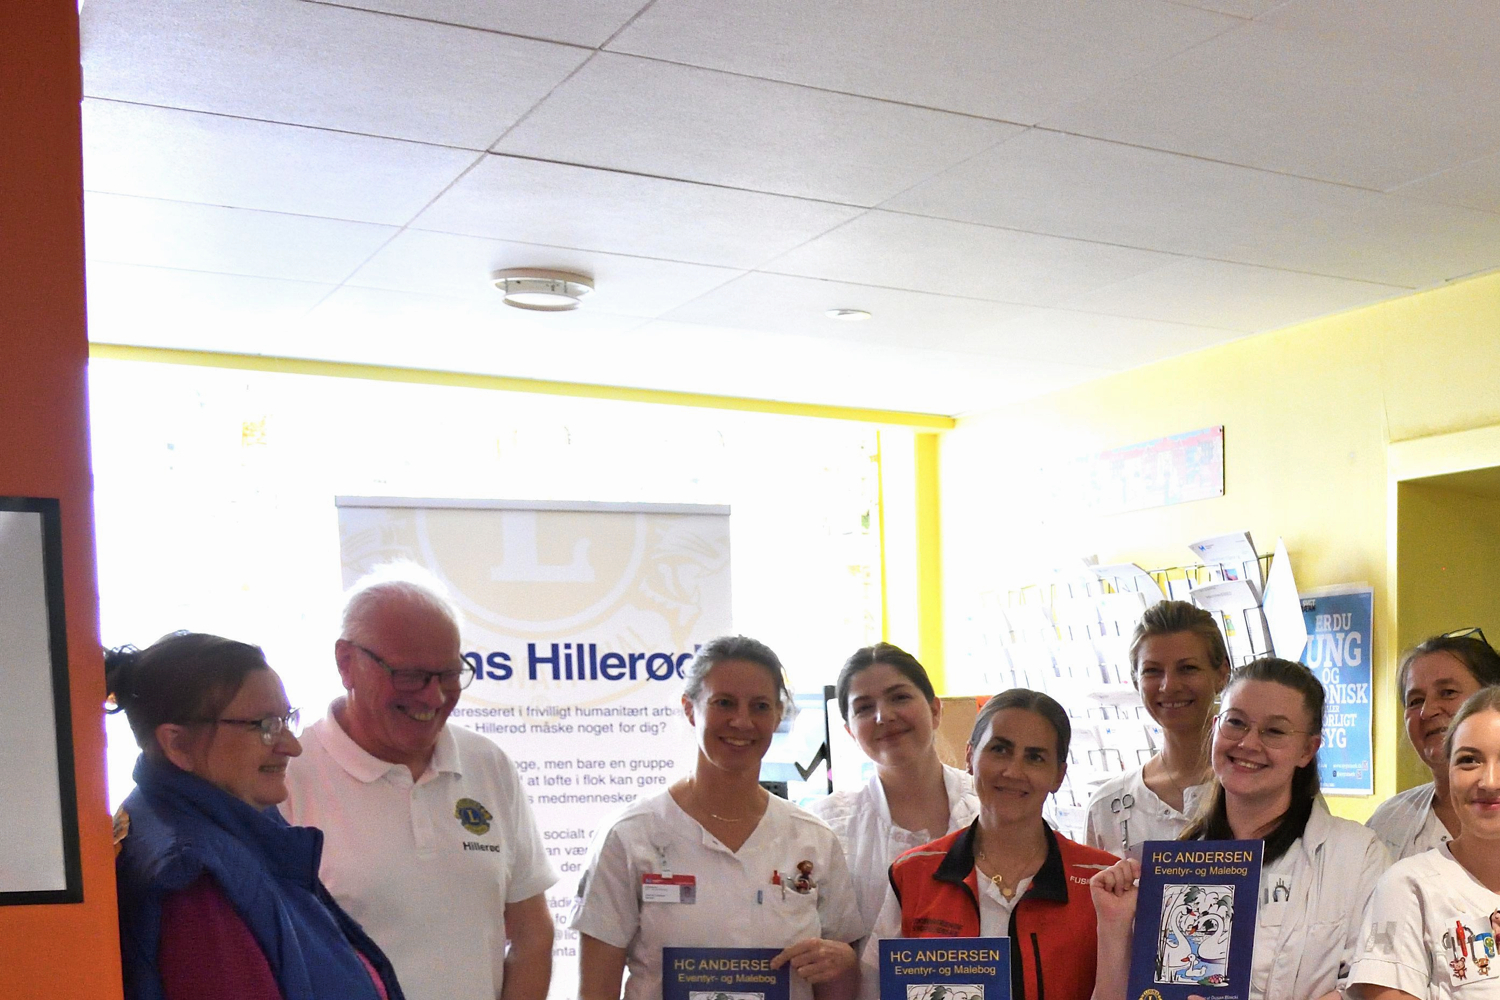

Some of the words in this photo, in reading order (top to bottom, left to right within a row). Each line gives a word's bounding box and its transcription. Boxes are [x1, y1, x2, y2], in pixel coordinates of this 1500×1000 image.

[1333, 612, 1352, 631] DU
[1306, 631, 1362, 669] UNG
[1321, 667, 1340, 685] OG
[526, 706, 571, 720] frivilligt
[530, 721, 573, 734] måske
[577, 723, 614, 736] noget
[619, 722, 636, 733] for
[639, 722, 667, 736] dig?
[544, 760, 573, 770] men
[576, 758, 606, 770] bare
[609, 760, 626, 769] en
[629, 760, 675, 772] gruppe
[527, 775, 540, 786] at
[609, 774, 633, 785] kan
[543, 828, 586, 840] socialt
[1152, 851, 1173, 863] HC
[1174, 851, 1253, 863] ANDERSEN
[1195, 867, 1207, 877] og
[1209, 866, 1248, 876] Malebog
[890, 951, 912, 963] HC
[915, 950, 1000, 963] ANDERSEN
[674, 958, 696, 971] HC
[699, 958, 772, 972] ANDERSE
[938, 967, 951, 977] og
[954, 965, 997, 976] Malebog
[720, 975, 733, 984] og
